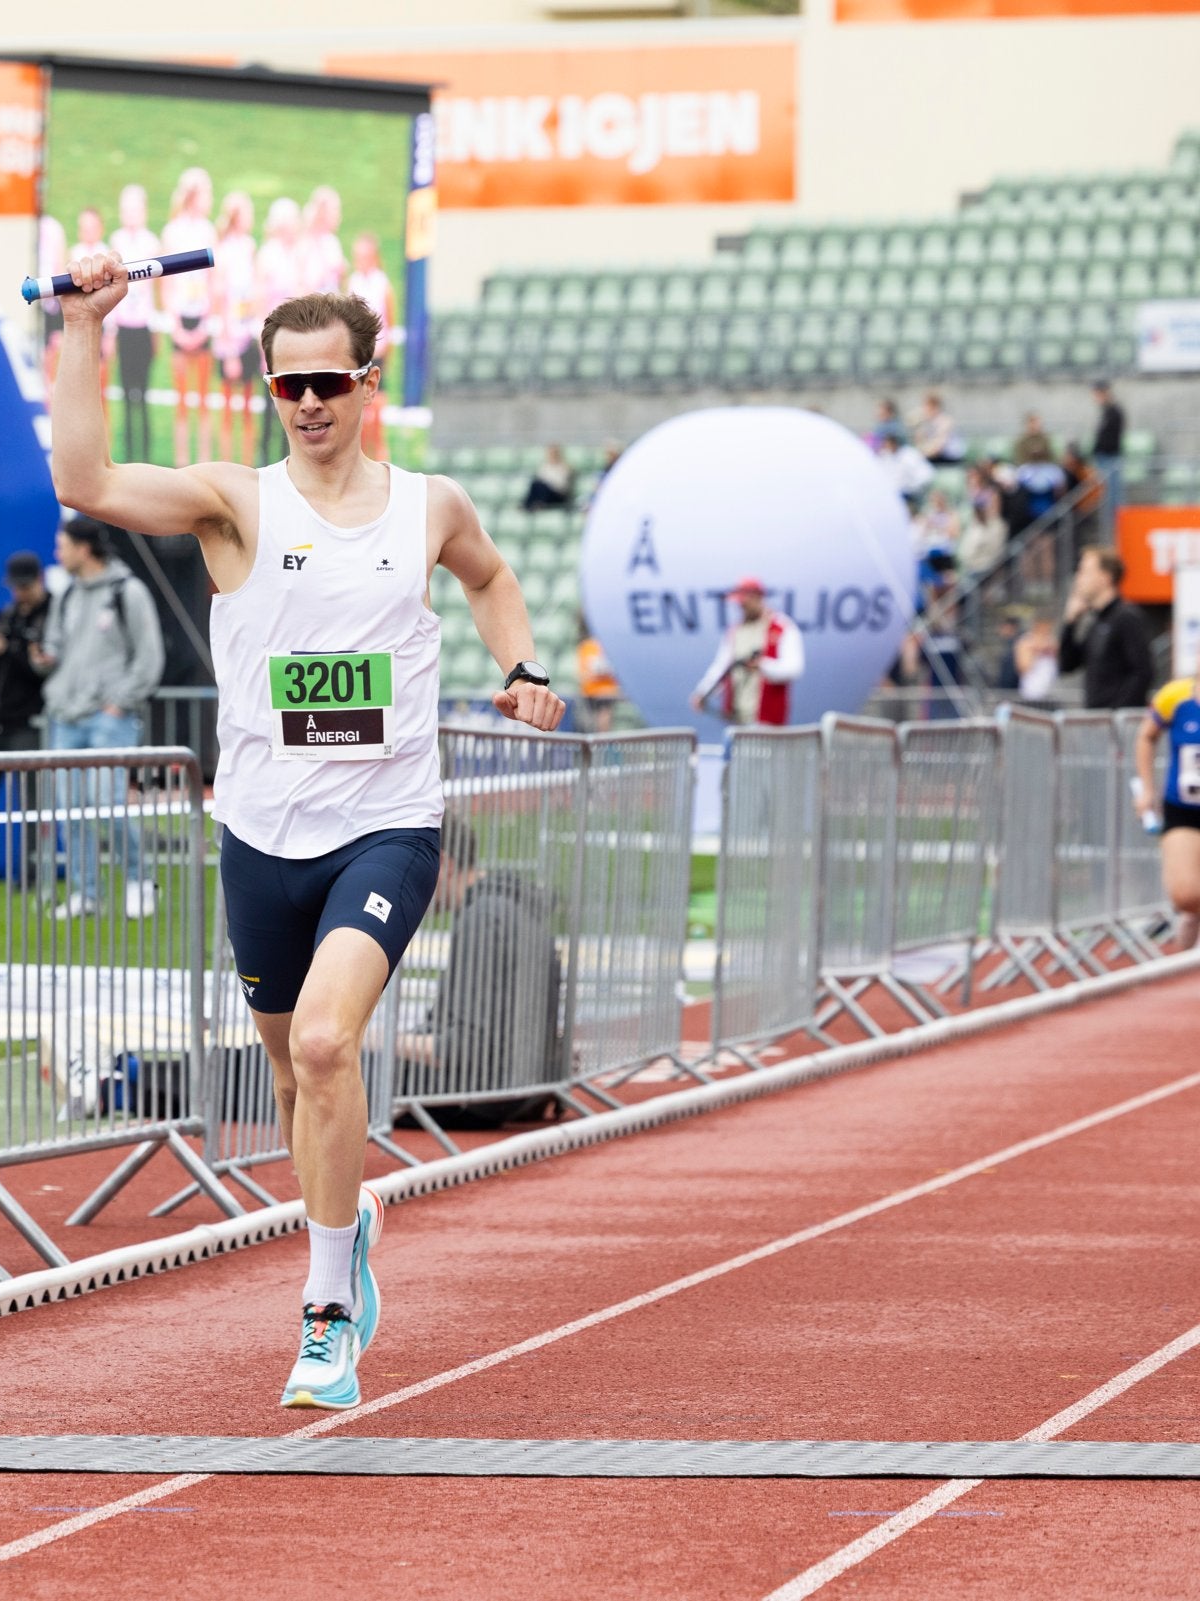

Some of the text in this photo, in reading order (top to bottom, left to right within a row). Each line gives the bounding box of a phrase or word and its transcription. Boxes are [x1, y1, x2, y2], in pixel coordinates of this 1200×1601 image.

[282, 554, 307, 571] EY
[628, 586, 893, 634] ENTLIOS
[284, 659, 372, 704] 3201
[306, 714, 317, 730] Å
[306, 731, 360, 743] ENERGI
